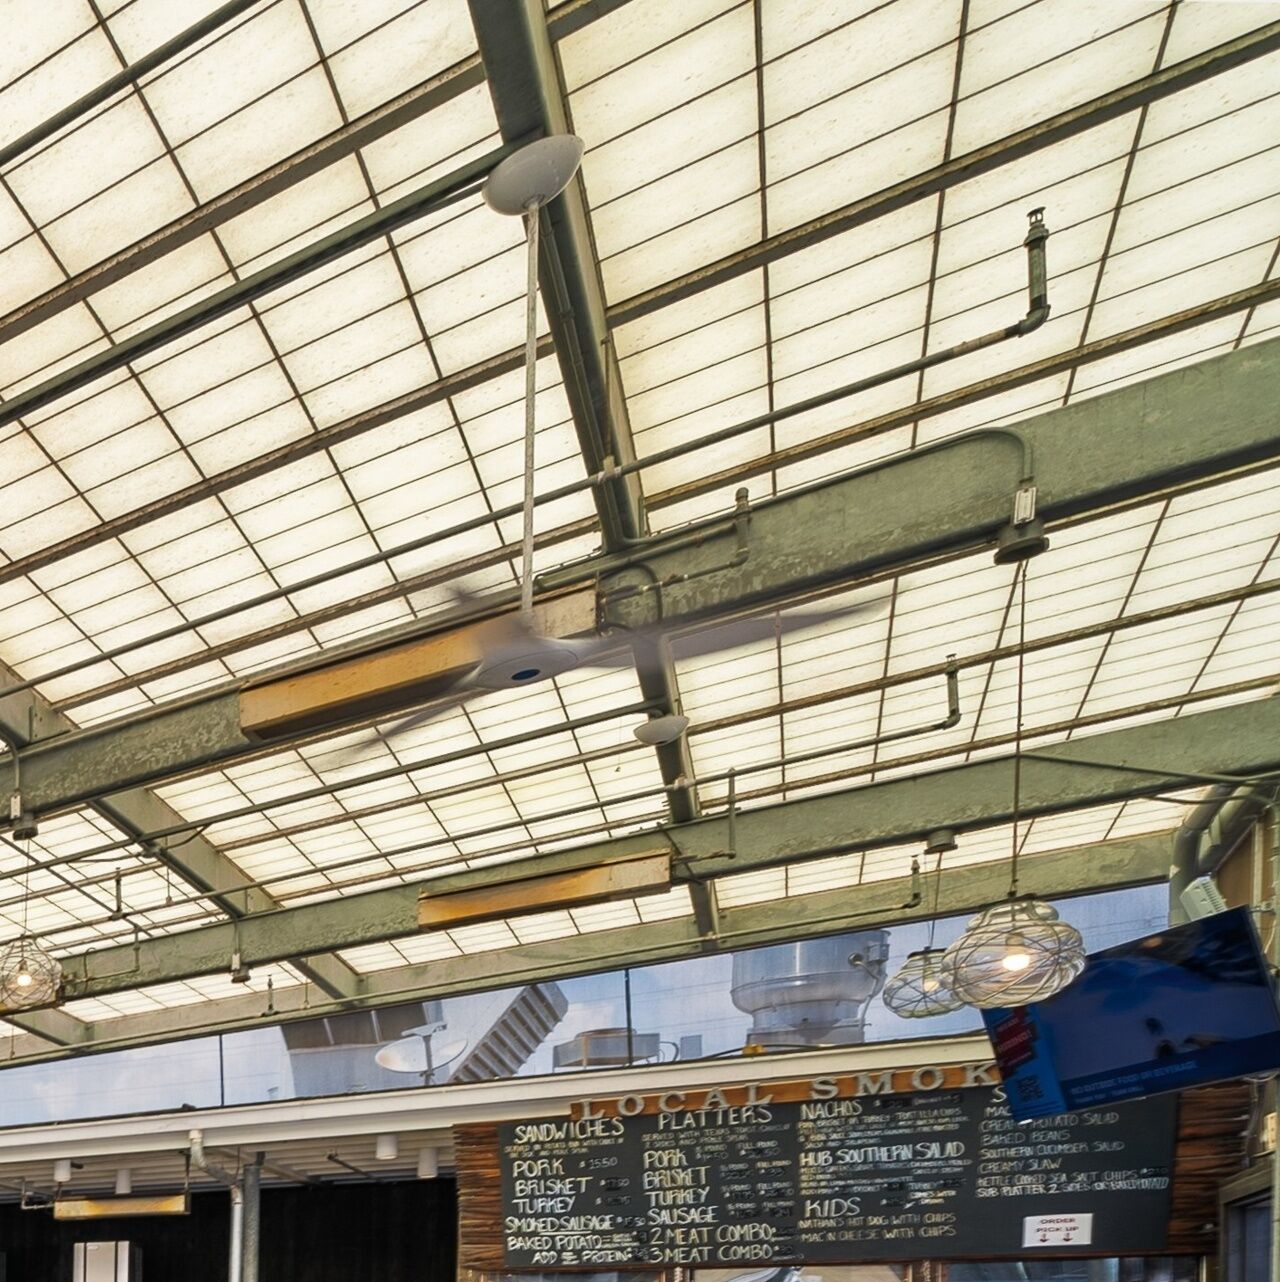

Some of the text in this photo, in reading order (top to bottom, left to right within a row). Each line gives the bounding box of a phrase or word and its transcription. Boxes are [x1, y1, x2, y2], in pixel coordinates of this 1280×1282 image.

[581, 1082, 774, 1121] LOCAL
[800, 1100, 863, 1119] NACHOS
[658, 1104, 773, 1130] PLATTERS
[1083, 1111, 1120, 1125] SALAD
[514, 1117, 625, 1144] SANDWICHES
[980, 1129, 1071, 1146] BAKED BEANS
[642, 1149, 688, 1169] PORK
[799, 1150, 833, 1167] HUB
[837, 1144, 913, 1164] SOUTHERN
[915, 1141, 965, 1159] SALAD
[978, 1141, 1125, 1160] SOUTHERN CUCUMBER SALAD
[512, 1158, 565, 1178] PORK
[977, 1160, 1025, 1174] CREAMY
[1028, 1157, 1062, 1170] SLAW
[1103, 1168, 1138, 1181] CHIPS
[514, 1176, 593, 1197] BRISKET
[642, 1165, 711, 1190] BRISKET
[644, 1186, 710, 1207] TURKEY
[1001, 1183, 1046, 1196] PLATTER
[1047, 1183, 1061, 1194] 2
[512, 1195, 576, 1214] TURKEY
[804, 1197, 861, 1218] KIDS
[504, 1216, 559, 1233] SMOKED
[560, 1214, 615, 1231] SAUSAGE
[647, 1205, 720, 1225] SAUSAGE
[868, 1215, 889, 1226] DOG
[891, 1213, 921, 1225] WITH
[922, 1212, 957, 1224] CHIPS
[649, 1227, 664, 1244] 2
[665, 1226, 713, 1245] MEAT
[715, 1222, 773, 1243] COMBO
[882, 1227, 915, 1239] WITH
[918, 1224, 957, 1238] CHIPS
[506, 1236, 552, 1251] BAKED
[555, 1235, 602, 1250] POTATO
[531, 1251, 558, 1264] ADD
[650, 1247, 663, 1263] 3
[663, 1246, 713, 1263] MEAT
[717, 1244, 773, 1260] COMBO
